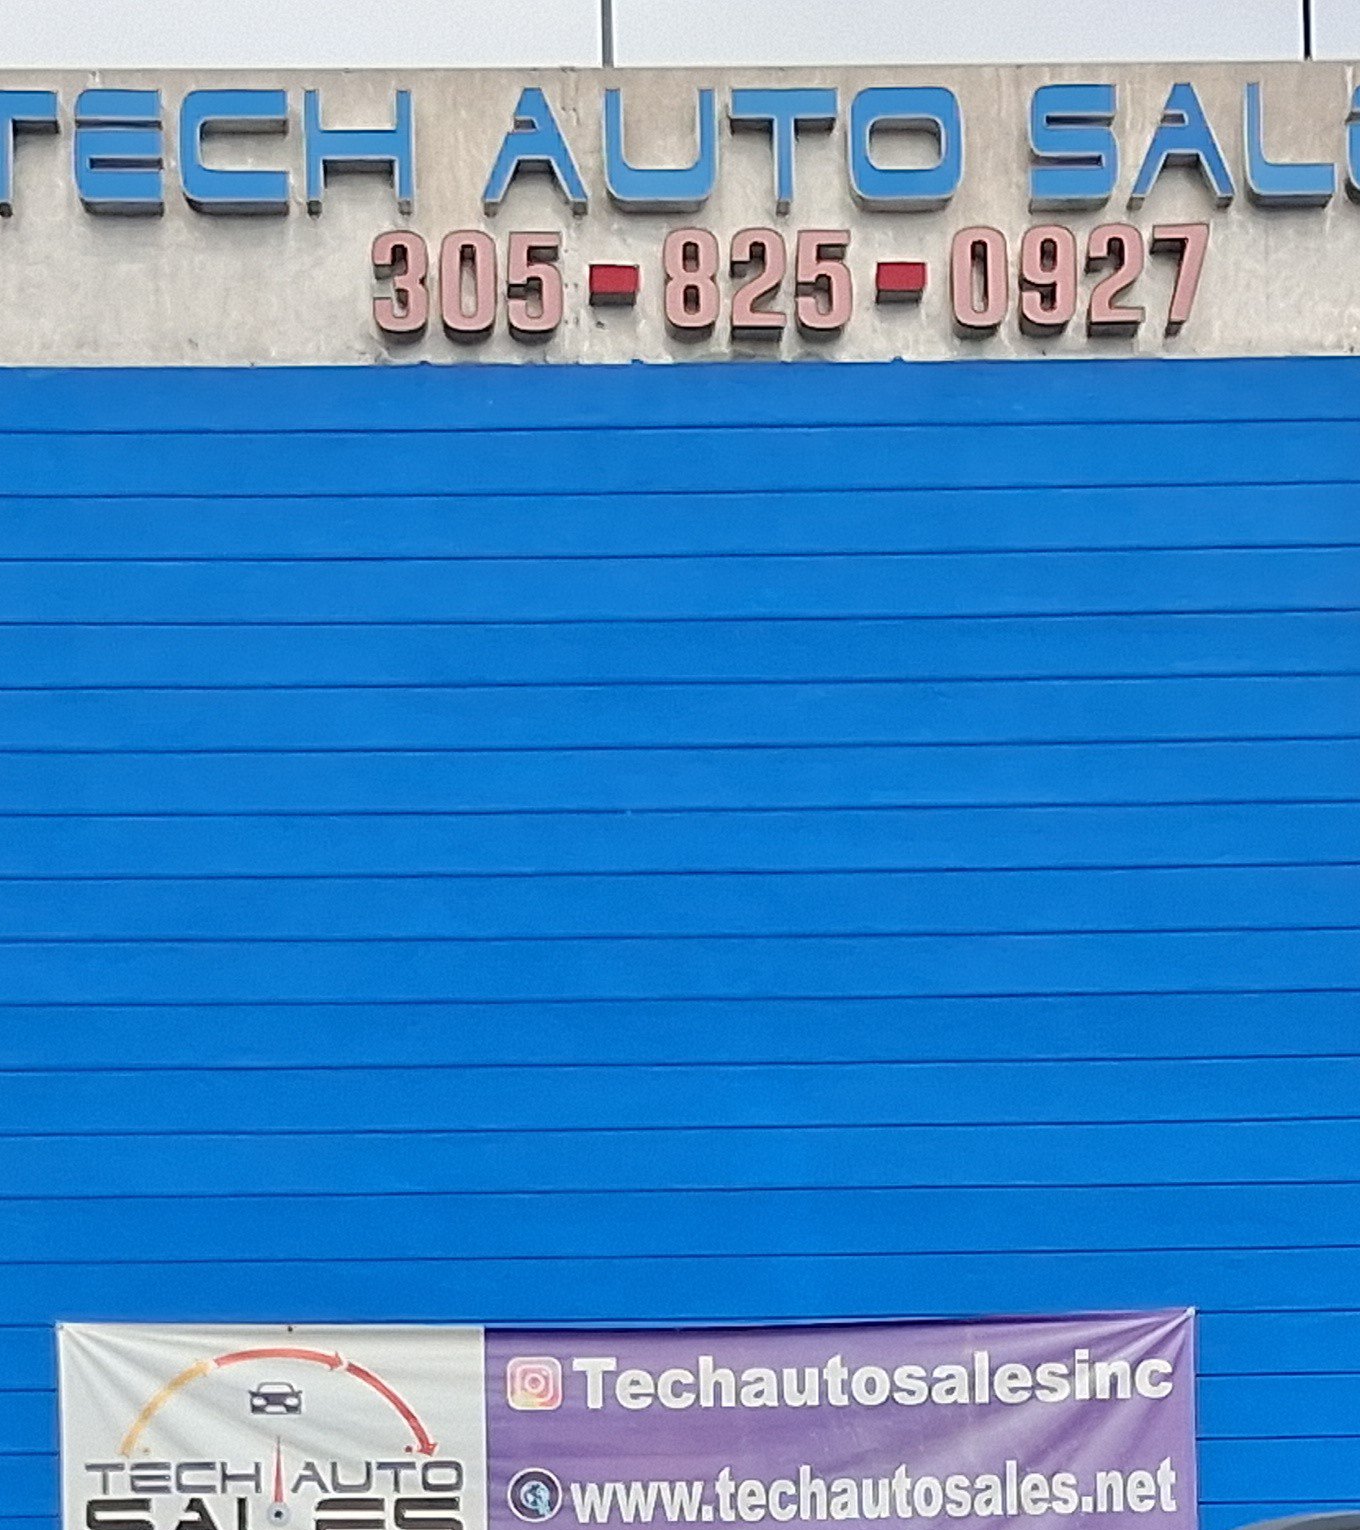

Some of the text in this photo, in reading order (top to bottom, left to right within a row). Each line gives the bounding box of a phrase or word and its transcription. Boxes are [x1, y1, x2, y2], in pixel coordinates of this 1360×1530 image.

[481, 86, 965, 211] AUTO
[571, 1349, 1174, 1409] Techautosalesinc
[84, 1459, 464, 1494] TECH AUTO
[570, 1456, 1178, 1523] www.techautosales.net
